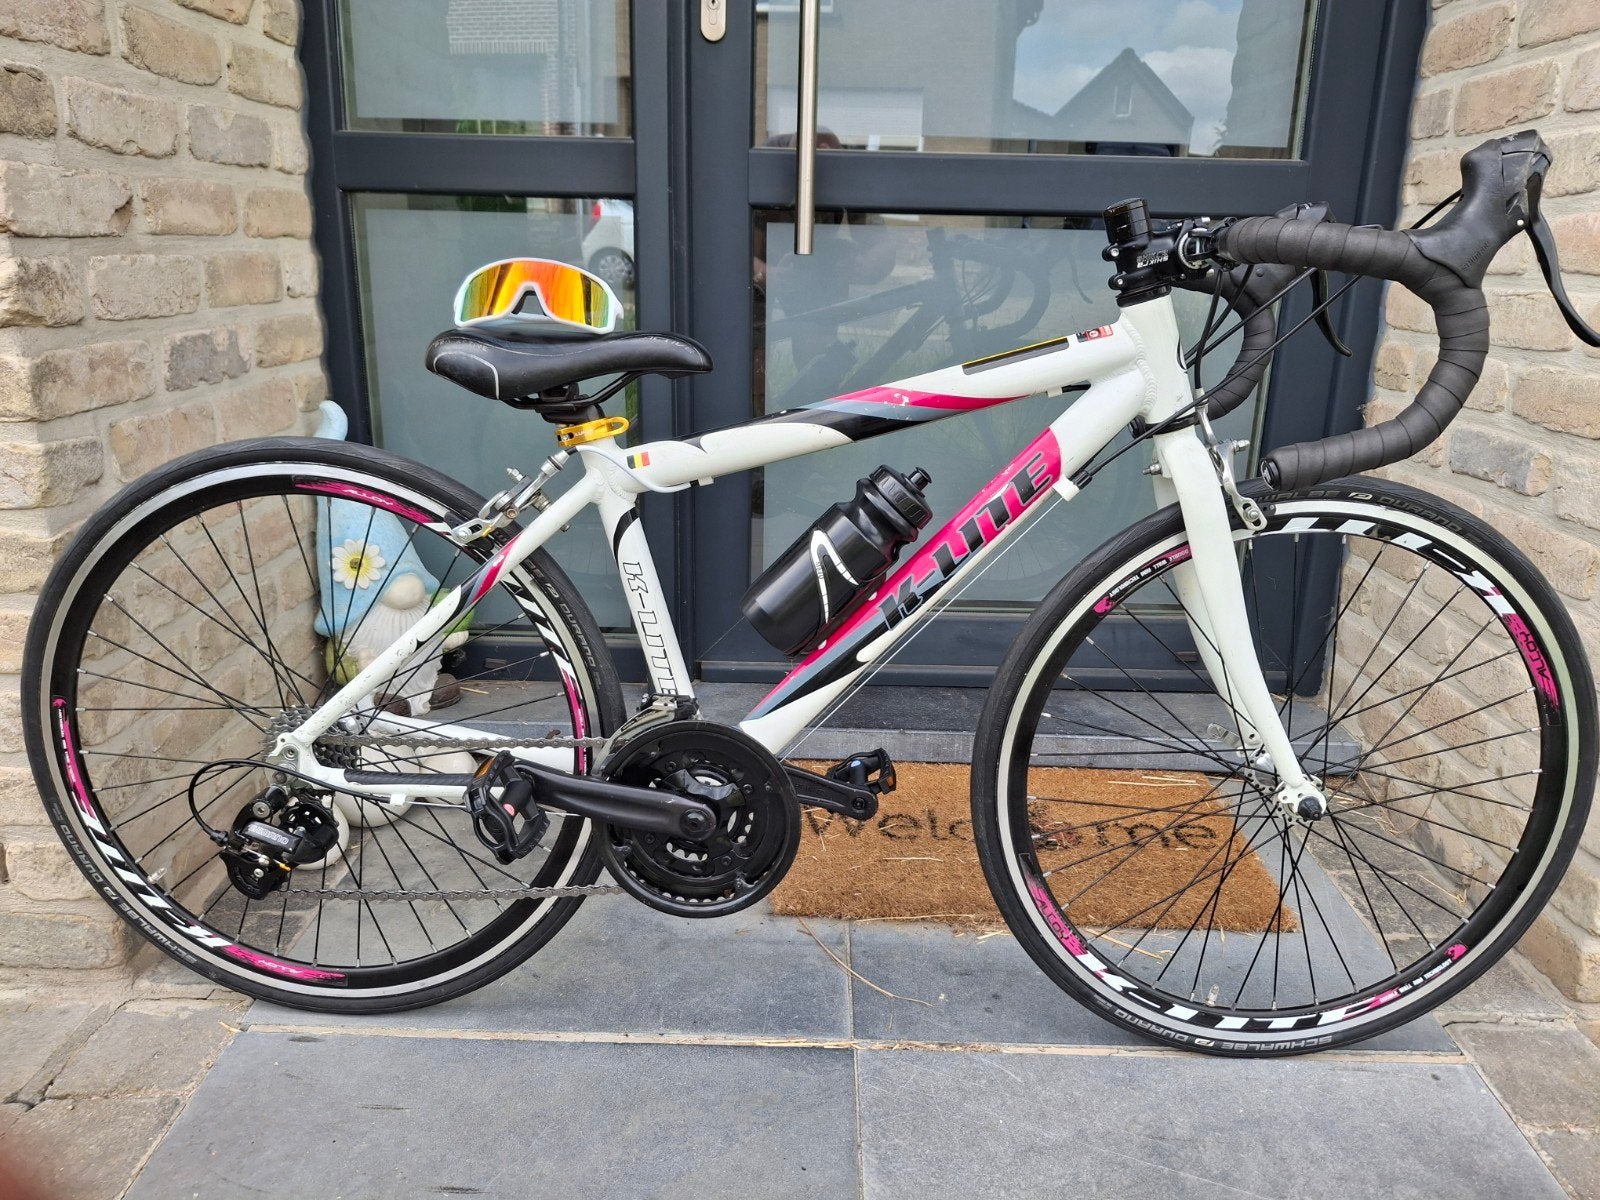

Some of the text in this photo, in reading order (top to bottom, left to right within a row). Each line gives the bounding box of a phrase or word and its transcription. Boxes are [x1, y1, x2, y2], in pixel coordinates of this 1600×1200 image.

[342, 488, 394, 507] ALLOY
[1379, 495, 1464, 533] DURANO
[878, 452, 1052, 631] K-LITE
[559, 603, 596, 667] DURANO
[1519, 631, 1551, 681] ALLOY
[60, 824, 198, 964] SCHWALBE DURANO
[1035, 898, 1069, 940] ALLOY
[257, 958, 303, 974] ALLOY
[1114, 1008, 1333, 1052] SCHWALBE DURANO
